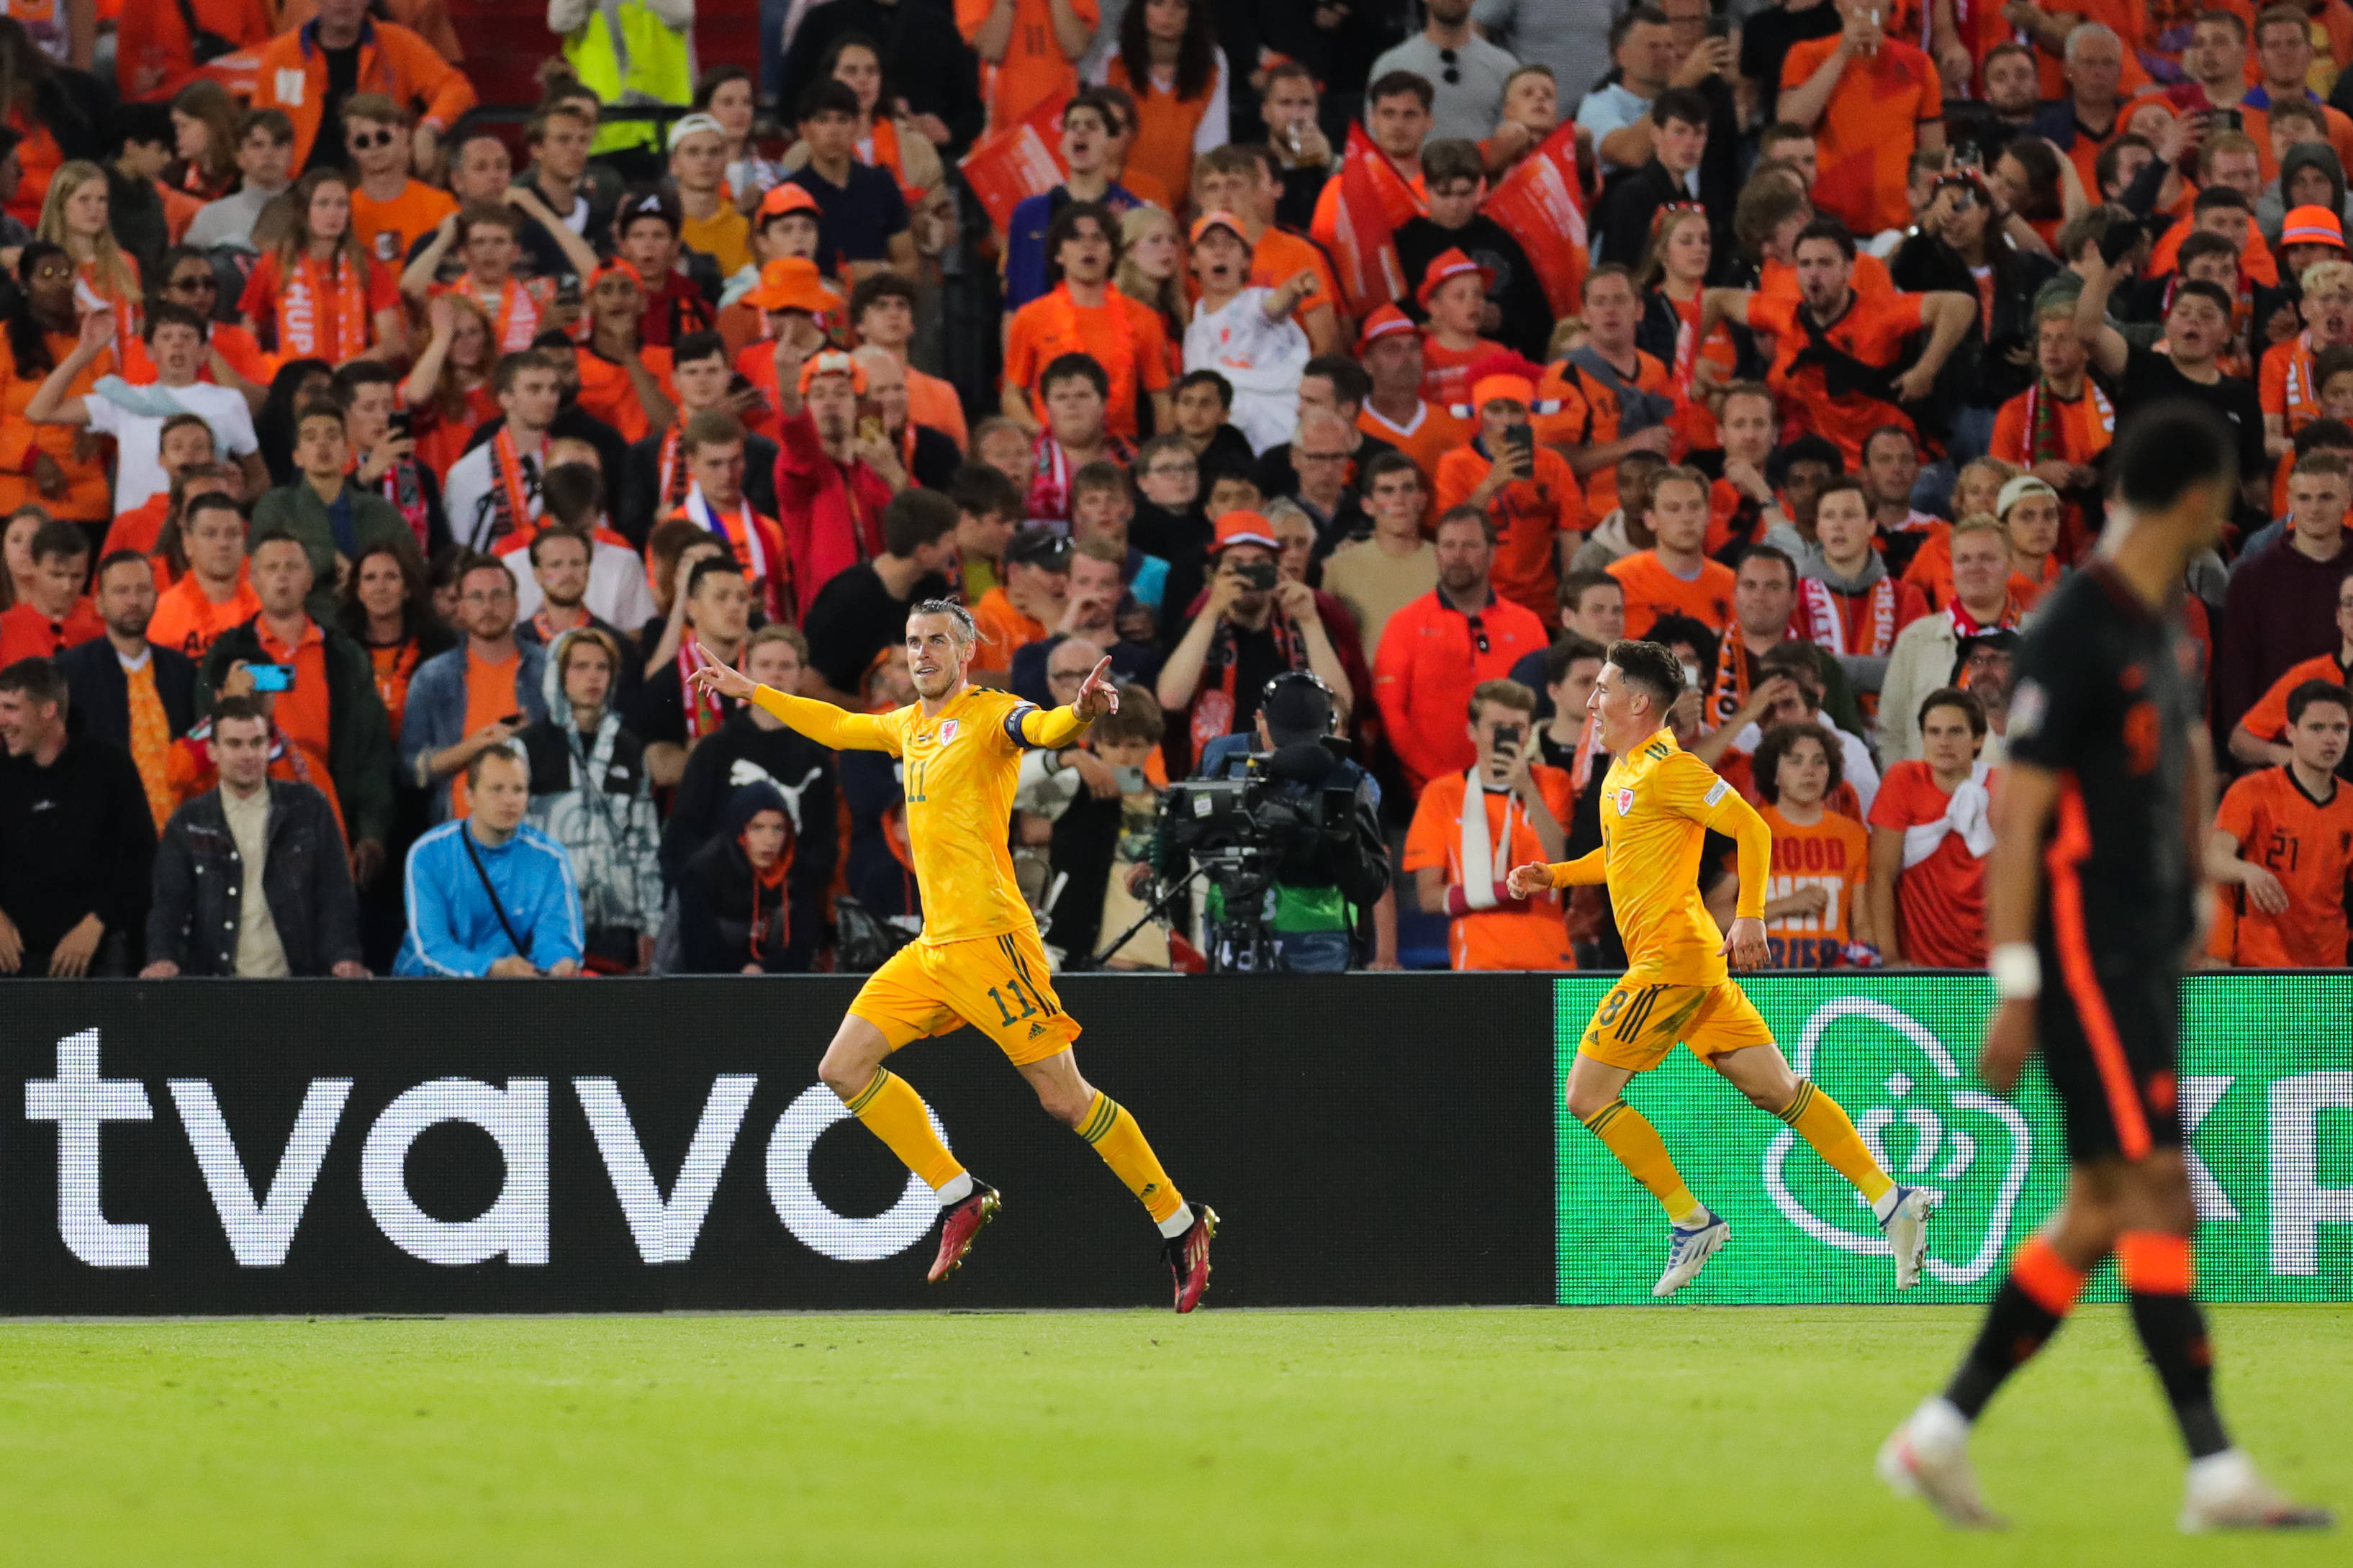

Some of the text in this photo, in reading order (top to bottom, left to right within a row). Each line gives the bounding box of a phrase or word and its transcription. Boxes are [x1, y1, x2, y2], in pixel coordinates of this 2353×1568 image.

[285, 284, 315, 354] HUP
[908, 760, 926, 803] 11
[2264, 833, 2300, 873] 21
[988, 979, 1037, 1027] 11
[1599, 990, 1628, 1026] 8
[24, 1027, 954, 1269] tvavo
